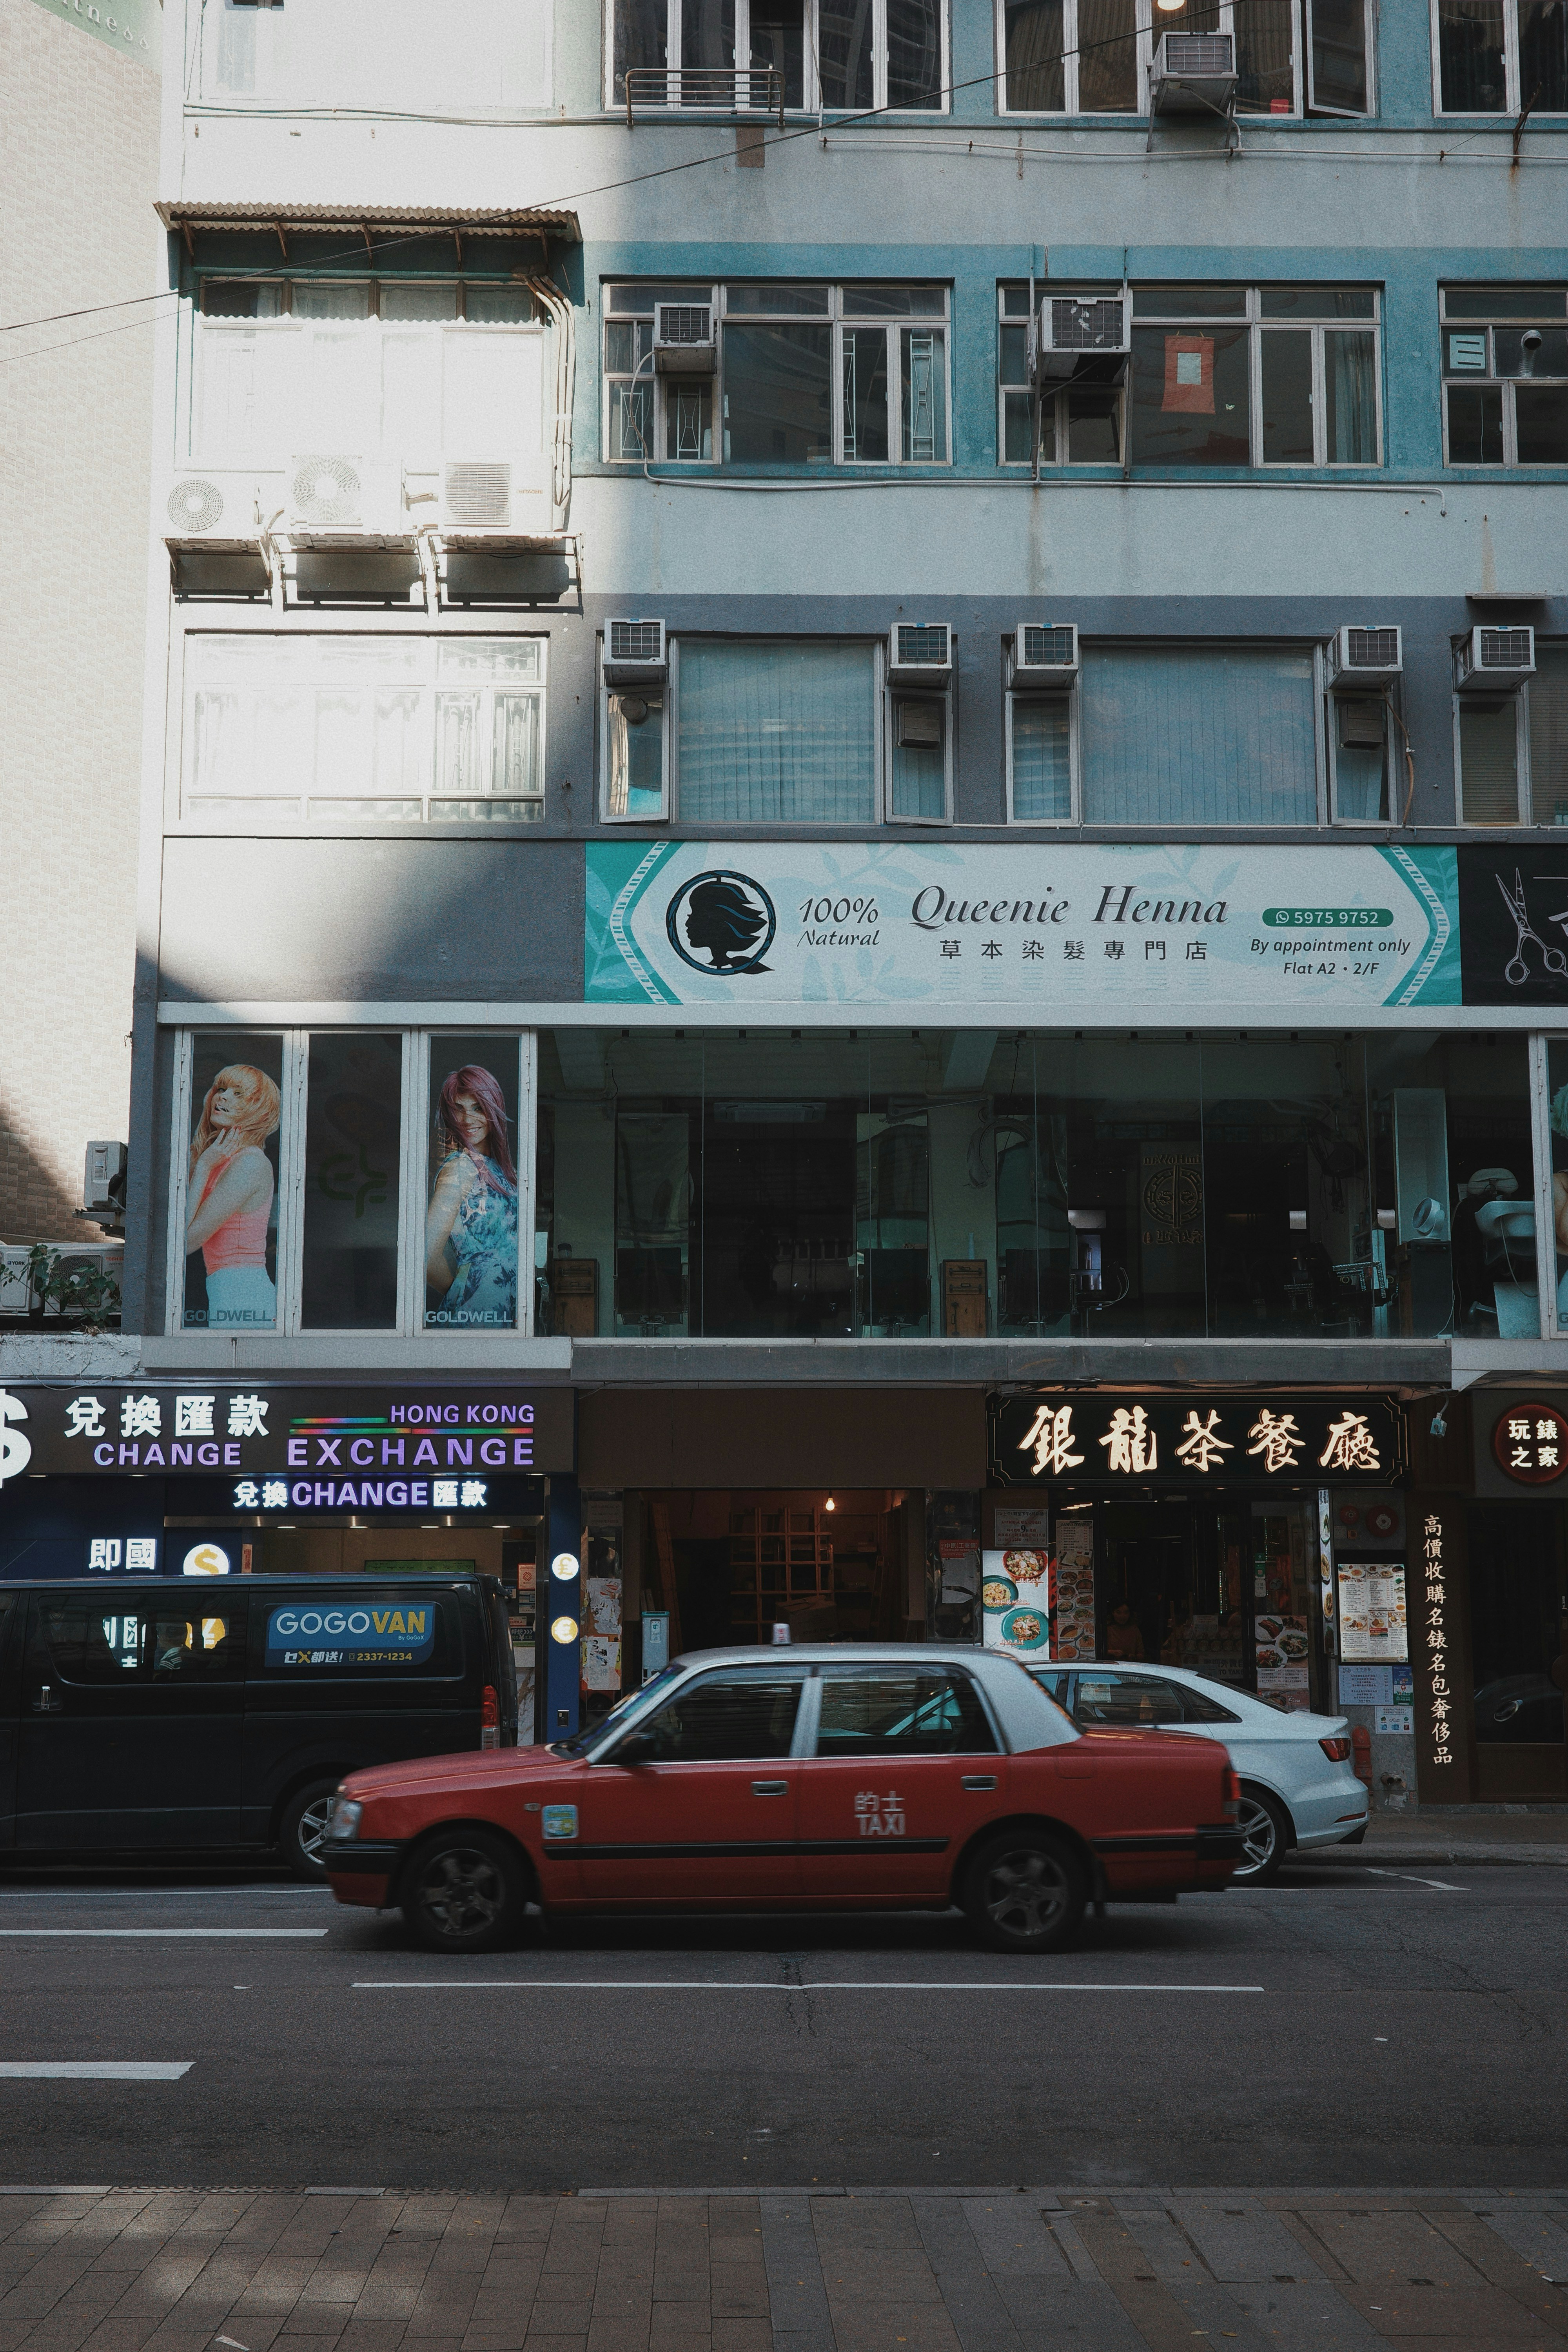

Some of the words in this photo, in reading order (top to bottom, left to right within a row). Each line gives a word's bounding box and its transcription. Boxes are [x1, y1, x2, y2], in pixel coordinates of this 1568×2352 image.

[799, 898, 878, 924] 100%
[908, 886, 1069, 932] Queenie
[1091, 886, 1229, 924] Henna
[1294, 911, 1335, 924] 5975
[1339, 911, 1379, 924] 9752
[797, 929, 880, 947] Natural
[1250, 939, 1269, 954] By
[1273, 938, 1372, 953] appointment
[1377, 938, 1410, 954] only
[940, 939, 1208, 960] 草本染髮專門店
[1284, 962, 1312, 975] Flat
[1317, 963, 1336, 975] A2
[1353, 963, 1379, 975] 2/F
[390, 1405, 459, 1423] HONG
[466, 1405, 534, 1423] KONG
[1017, 1405, 1381, 1475] 銀龍茶餐廳
[1508, 1419, 1558, 1440] 玩錶
[94, 1443, 241, 1466] CHANGE
[287, 1438, 534, 1466] EXCHANGE
[1510, 1446, 1559, 1467] 之家
[292, 1482, 428, 1506] CHANGE
[276, 1611, 425, 1634] GOGOVAN
[1423, 1514, 1453, 1764] 高價收購名錶名包奢侈品
[357, 1652, 412, 1661] 2337-1234
[854, 1813, 906, 1836] TAXI
